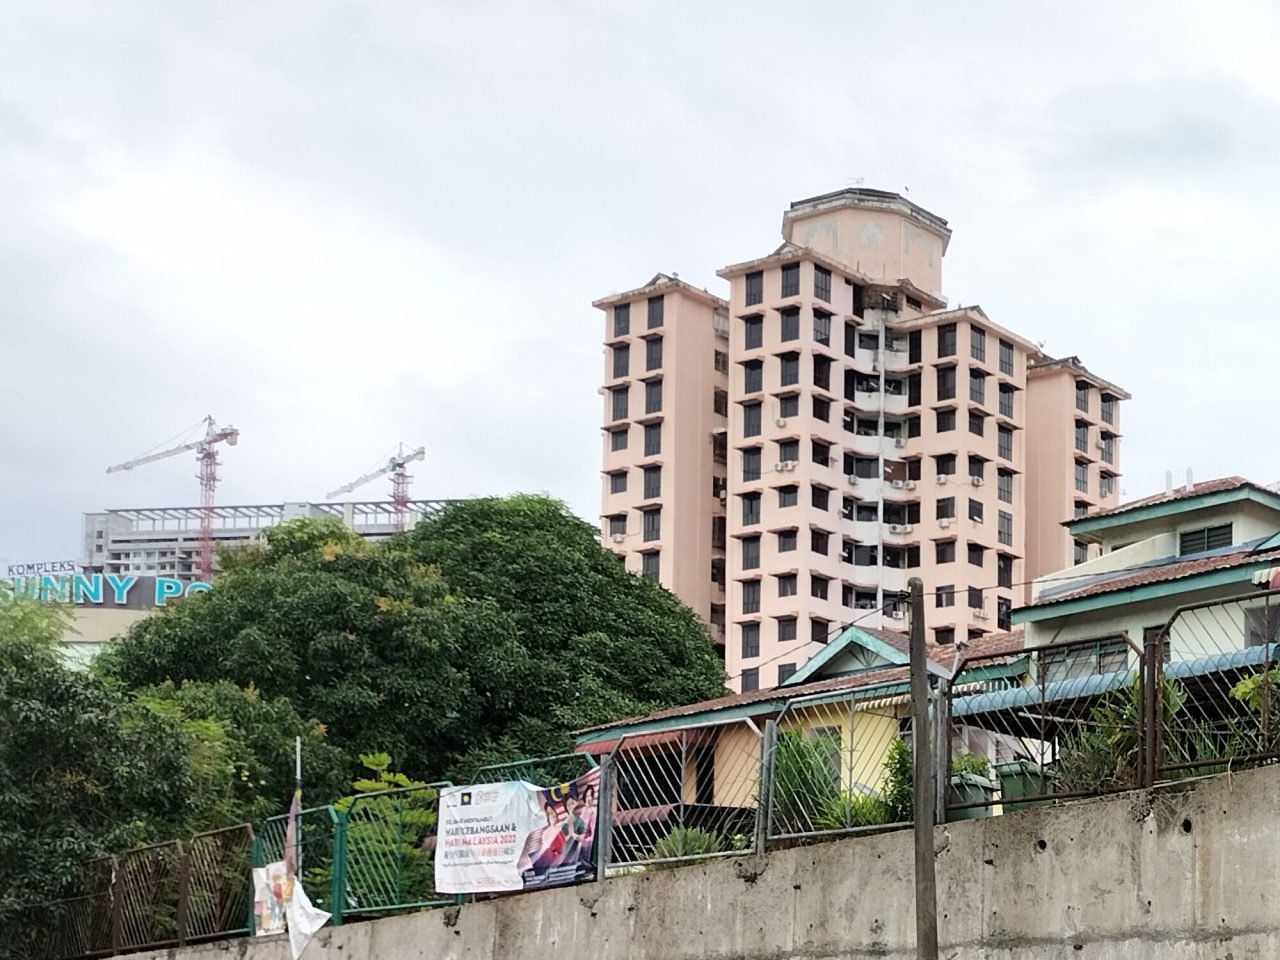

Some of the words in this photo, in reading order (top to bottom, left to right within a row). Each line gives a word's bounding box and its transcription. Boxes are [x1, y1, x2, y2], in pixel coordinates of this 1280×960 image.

[8, 561, 75, 576] KOMPLEKS
[511, 822, 518, 832] &
[462, 836, 498, 846] MALAYSIA
[500, 834, 517, 844] 2022
